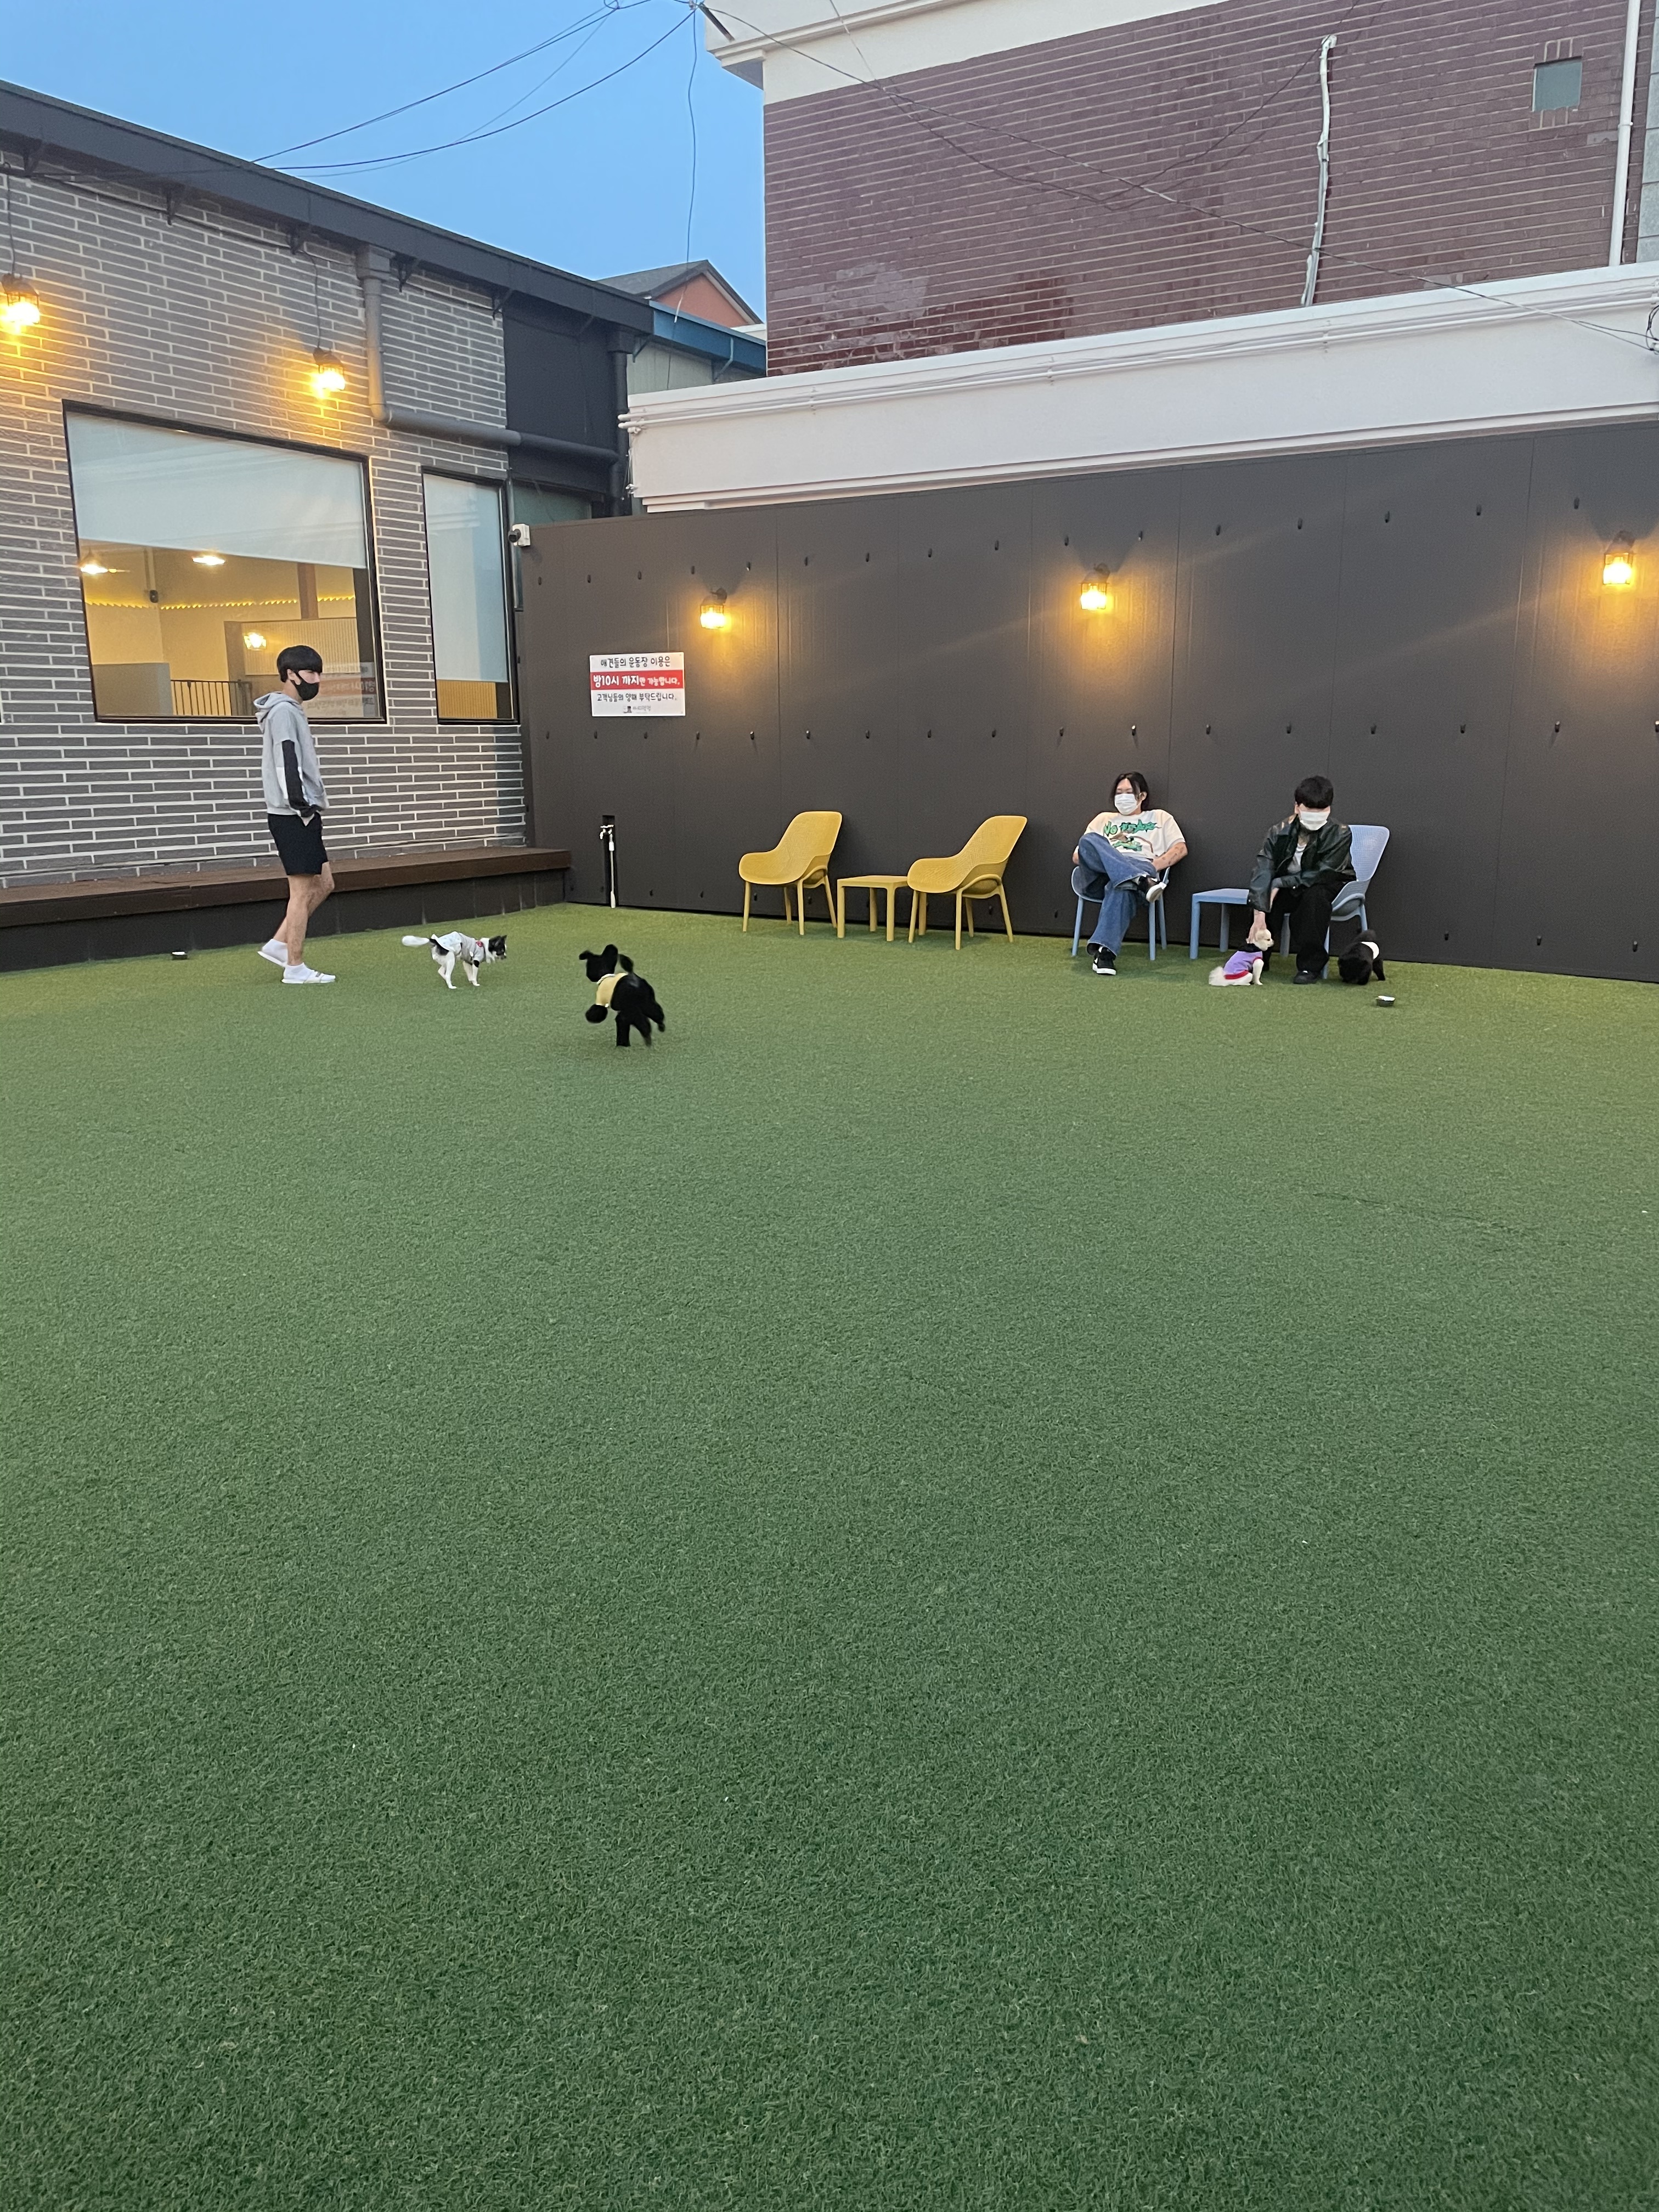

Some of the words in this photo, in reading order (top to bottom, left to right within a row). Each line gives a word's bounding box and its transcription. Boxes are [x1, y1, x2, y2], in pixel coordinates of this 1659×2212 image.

[601, 657, 627, 668] 애견들의
[629, 657, 648, 668] 운동장
[651, 656, 670, 667] 이용은
[597, 693, 624, 702] 고객님들의
[625, 693, 637, 702] 양해
[639, 692, 677, 702] 부탁드립니다.
